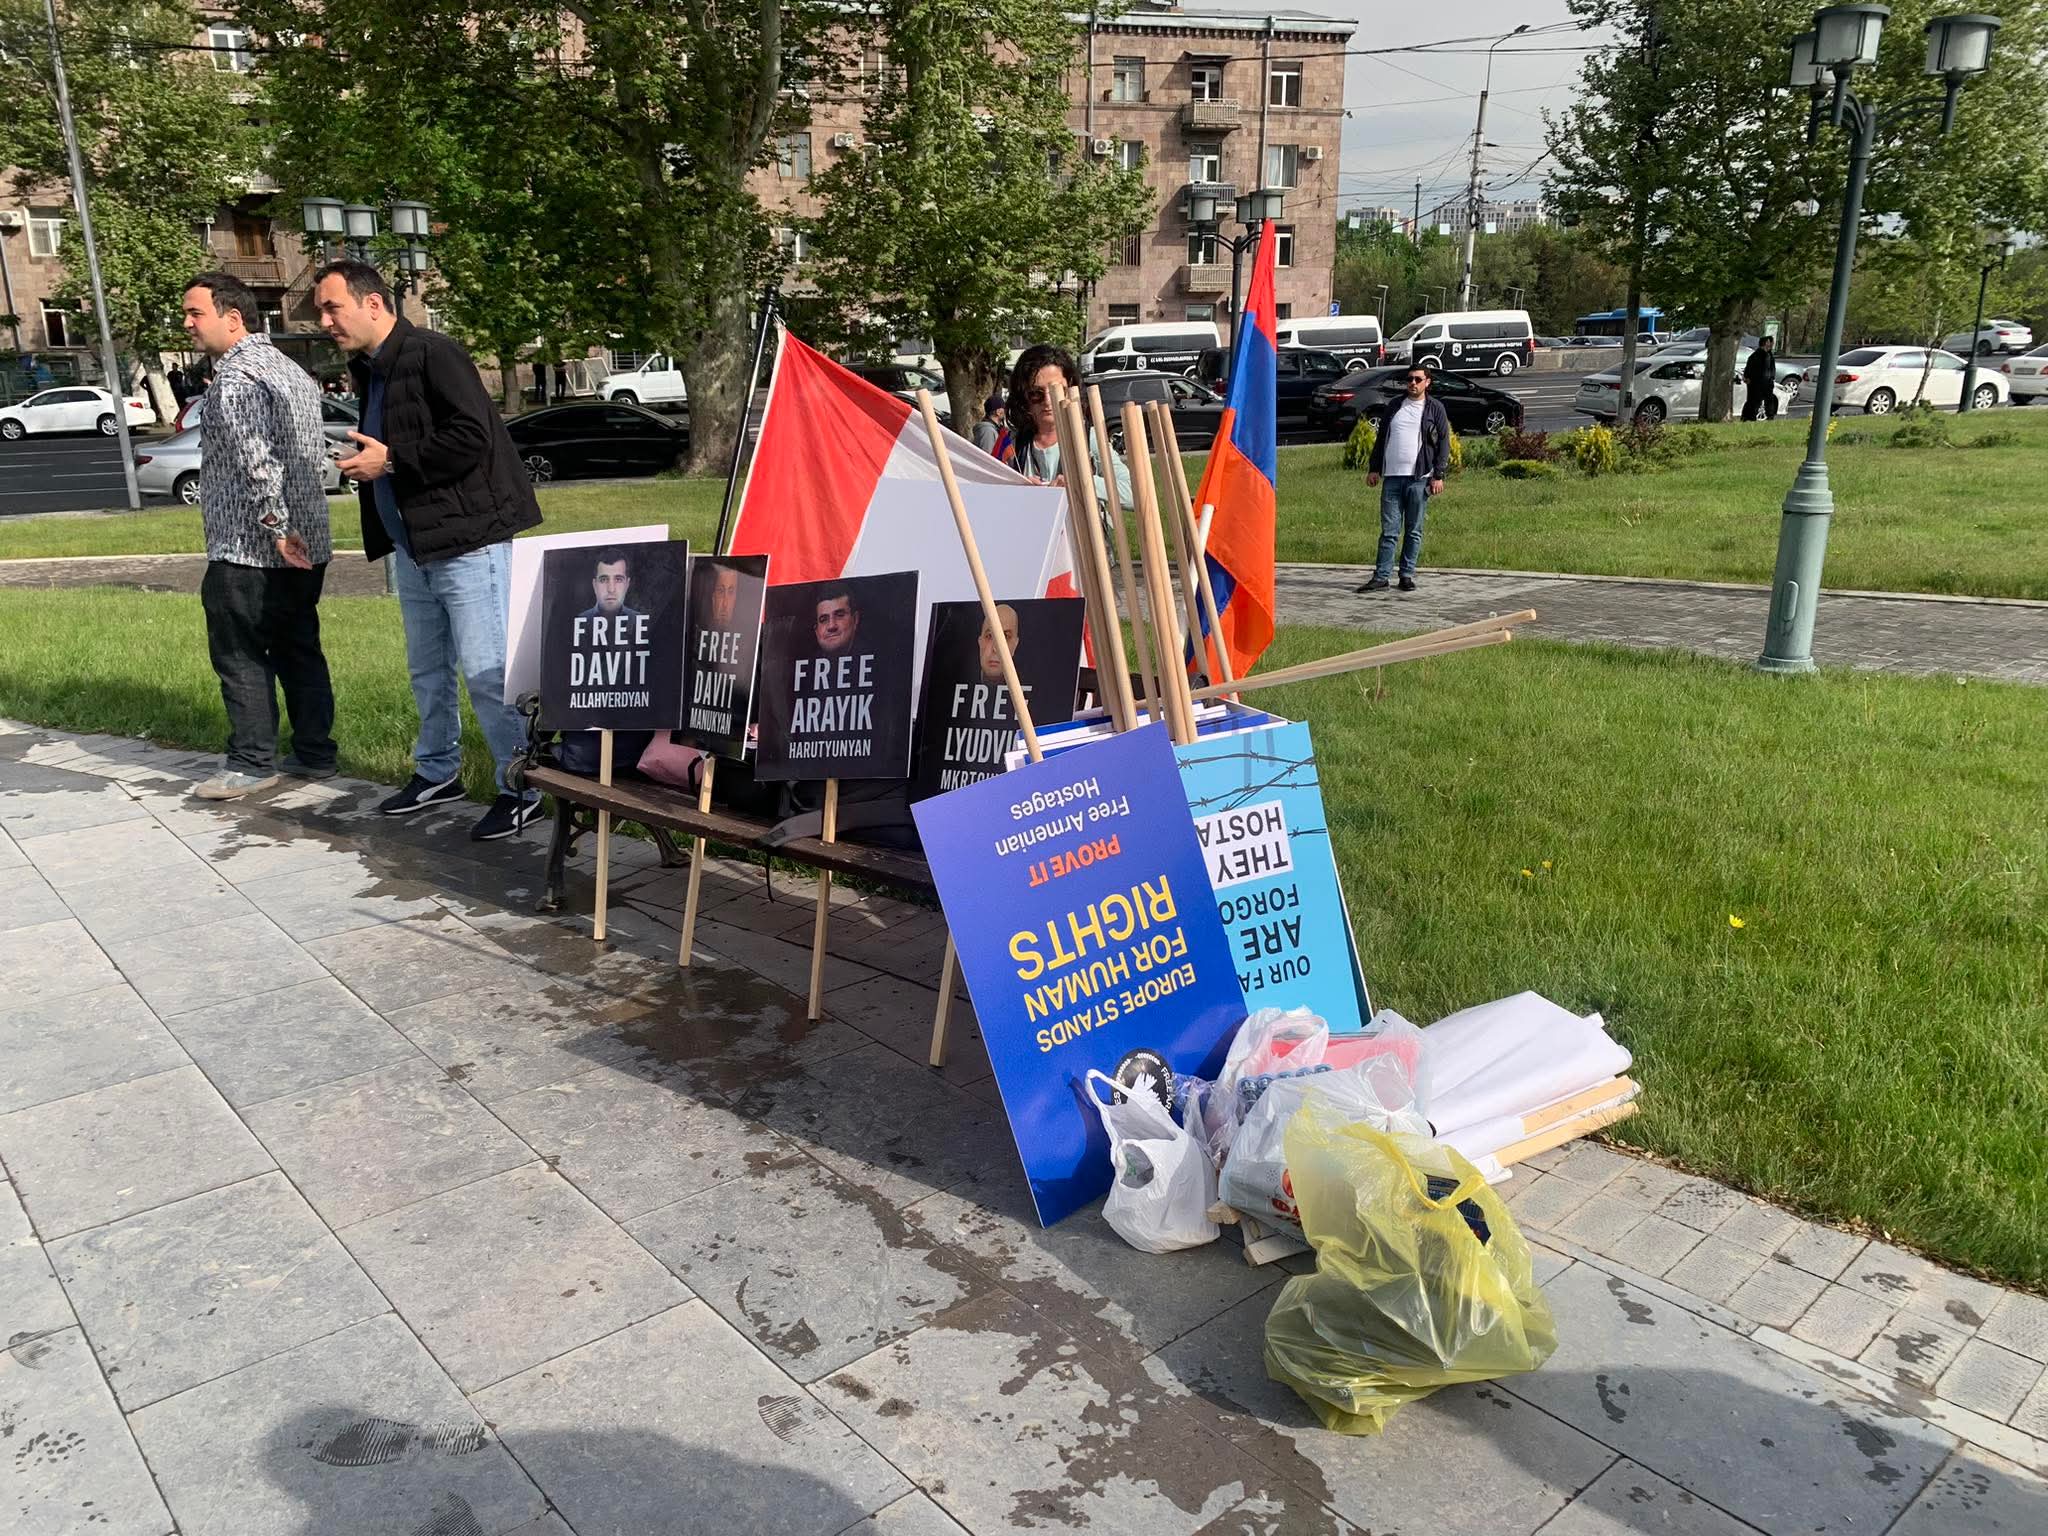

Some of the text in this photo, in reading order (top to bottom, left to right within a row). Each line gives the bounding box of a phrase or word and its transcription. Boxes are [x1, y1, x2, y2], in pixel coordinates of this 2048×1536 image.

[573, 614, 650, 647] FREE
[698, 630, 743, 665] FREE
[570, 650, 651, 686] DAVIT
[793, 654, 874, 692] FREE
[569, 691, 650, 709] ALLAHVERDYAN
[693, 670, 737, 709] DAVIT
[689, 707, 732, 735] MANUKYAN
[790, 694, 874, 733] ARAYIK
[788, 739, 872, 759] HARUTYUNYAN
[944, 727, 1014, 764] LYUDVI
[1010, 777, 1101, 820] Hostages
[994, 795, 1131, 856] Free Armenian
[1195, 806, 1283, 848] HOSTA
[1029, 834, 1121, 888] PROVE IT
[1217, 841, 1289, 883] THEY
[1218, 883, 1300, 925] FORGO
[1008, 874, 1177, 981] RIGHTS
[1240, 915, 1301, 962] ARE
[1023, 926, 1188, 1022] FOR HUMAN
[1238, 955, 1311, 993] OUR FA
[1036, 962, 1197, 1052] EUROPE STANDS
